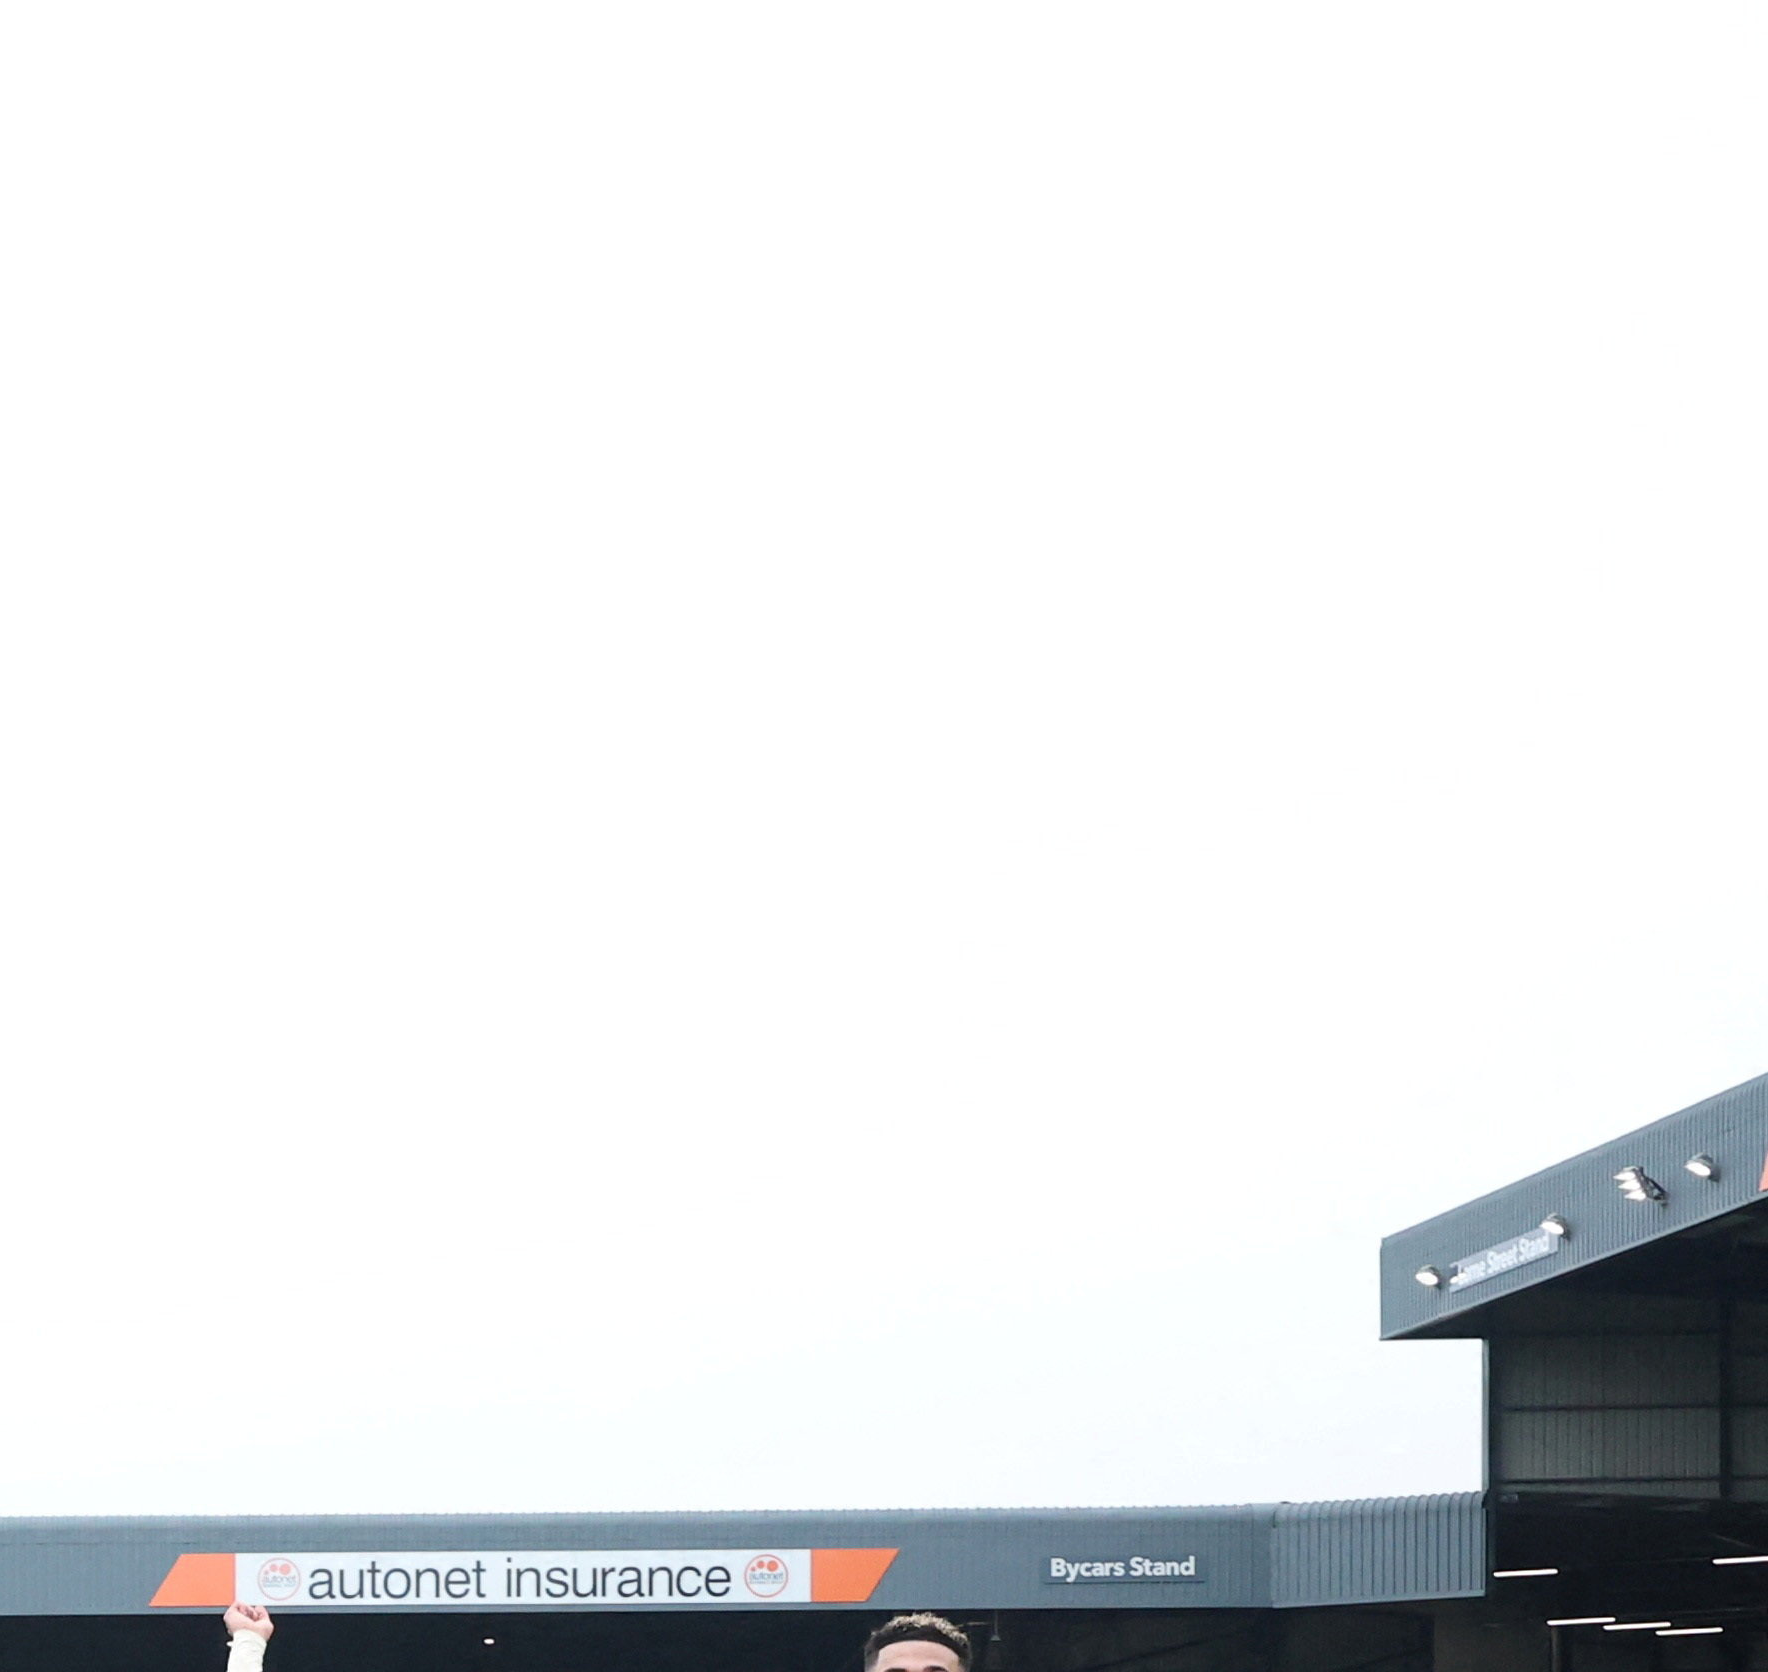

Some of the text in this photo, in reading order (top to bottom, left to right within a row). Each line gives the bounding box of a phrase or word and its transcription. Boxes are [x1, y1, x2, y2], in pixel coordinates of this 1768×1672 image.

[308, 1557, 731, 1600] autonet insurance
[1051, 1555, 1196, 1582] Bycars Stand
